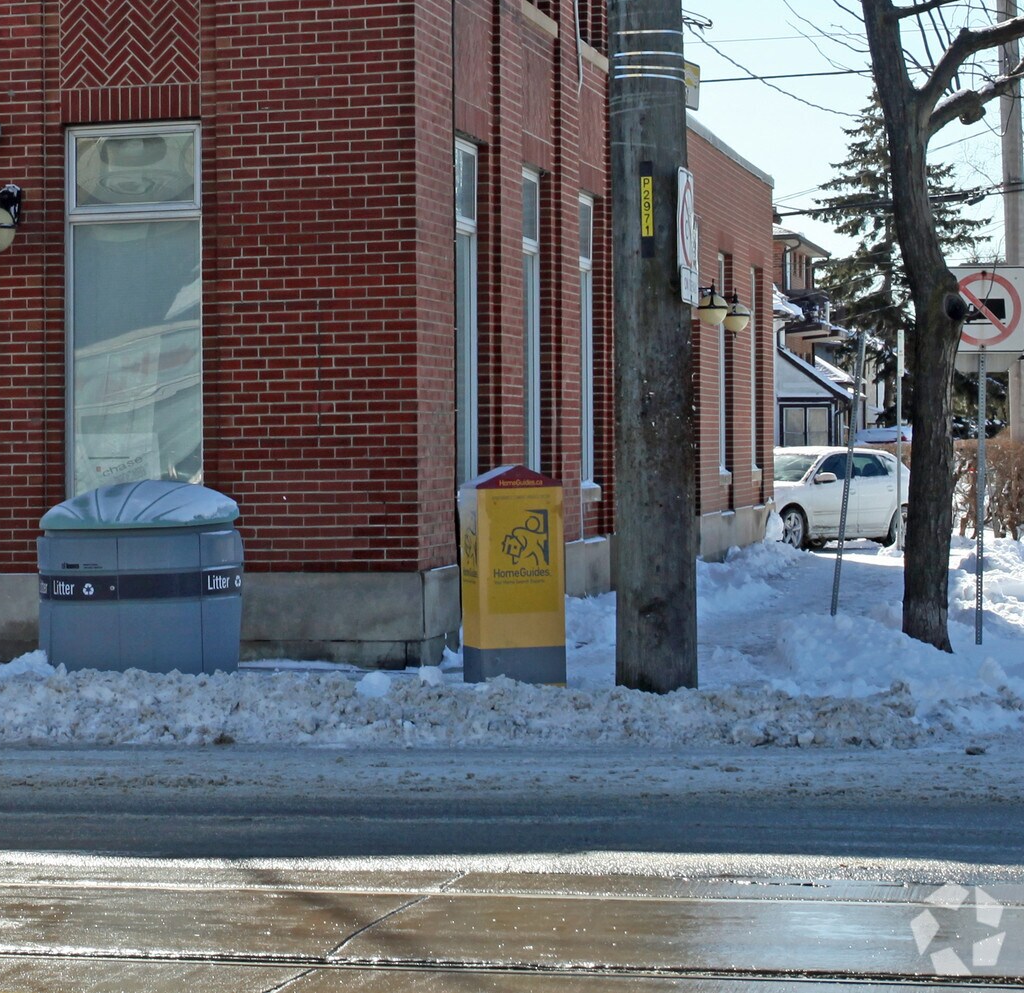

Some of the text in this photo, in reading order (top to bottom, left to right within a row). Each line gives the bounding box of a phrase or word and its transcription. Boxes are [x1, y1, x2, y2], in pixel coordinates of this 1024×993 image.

[102, 455, 143, 478] chase
[499, 479, 543, 487] HomeGuides.ca
[493, 567, 550, 578] HomeGuides
[53, 580, 75, 596] Litter
[207, 575, 230, 591] Litter
